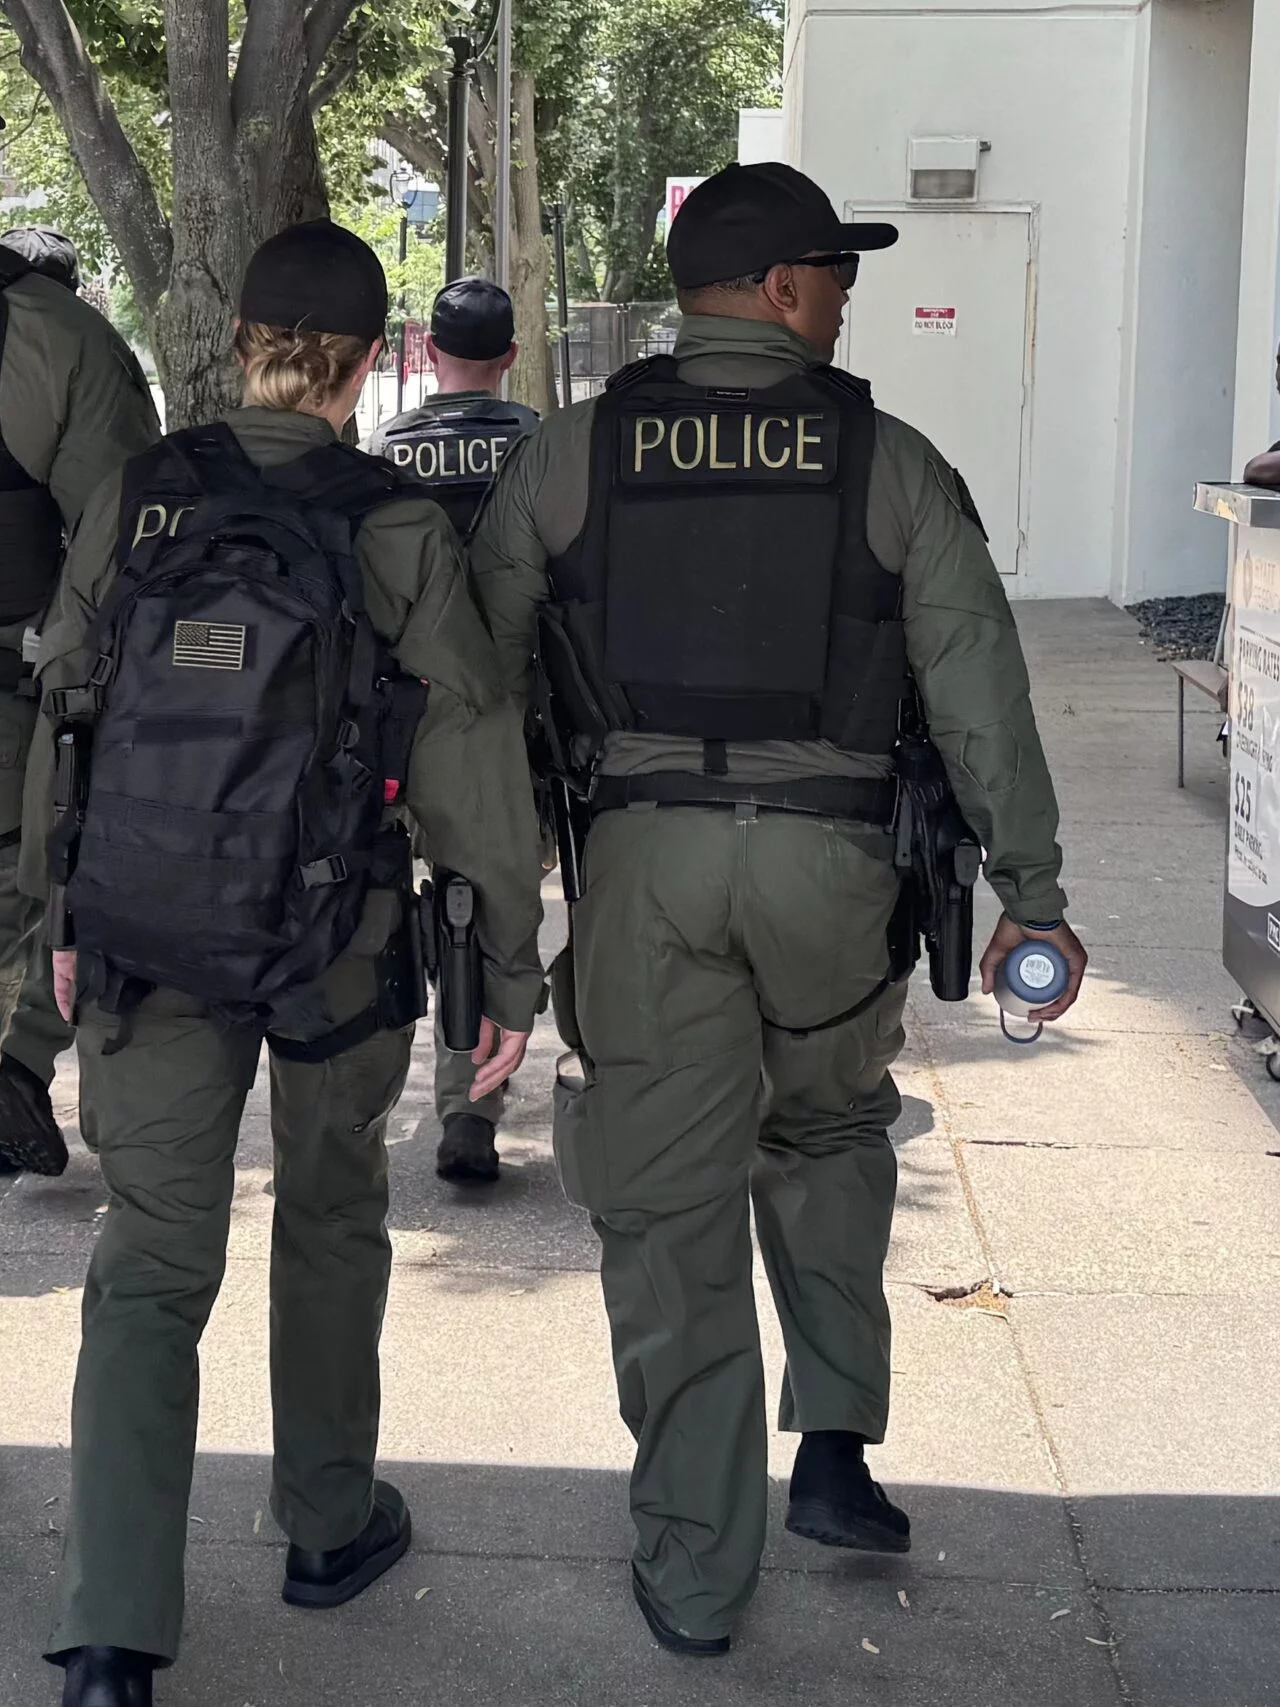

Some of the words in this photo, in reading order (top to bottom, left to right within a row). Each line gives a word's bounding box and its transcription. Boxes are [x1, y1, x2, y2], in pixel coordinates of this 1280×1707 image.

[936, 321, 953, 330] BLOCK
[634, 413, 824, 473] POLICE
[1238, 681, 1254, 731] $38
[1235, 771, 1251, 823] $25
